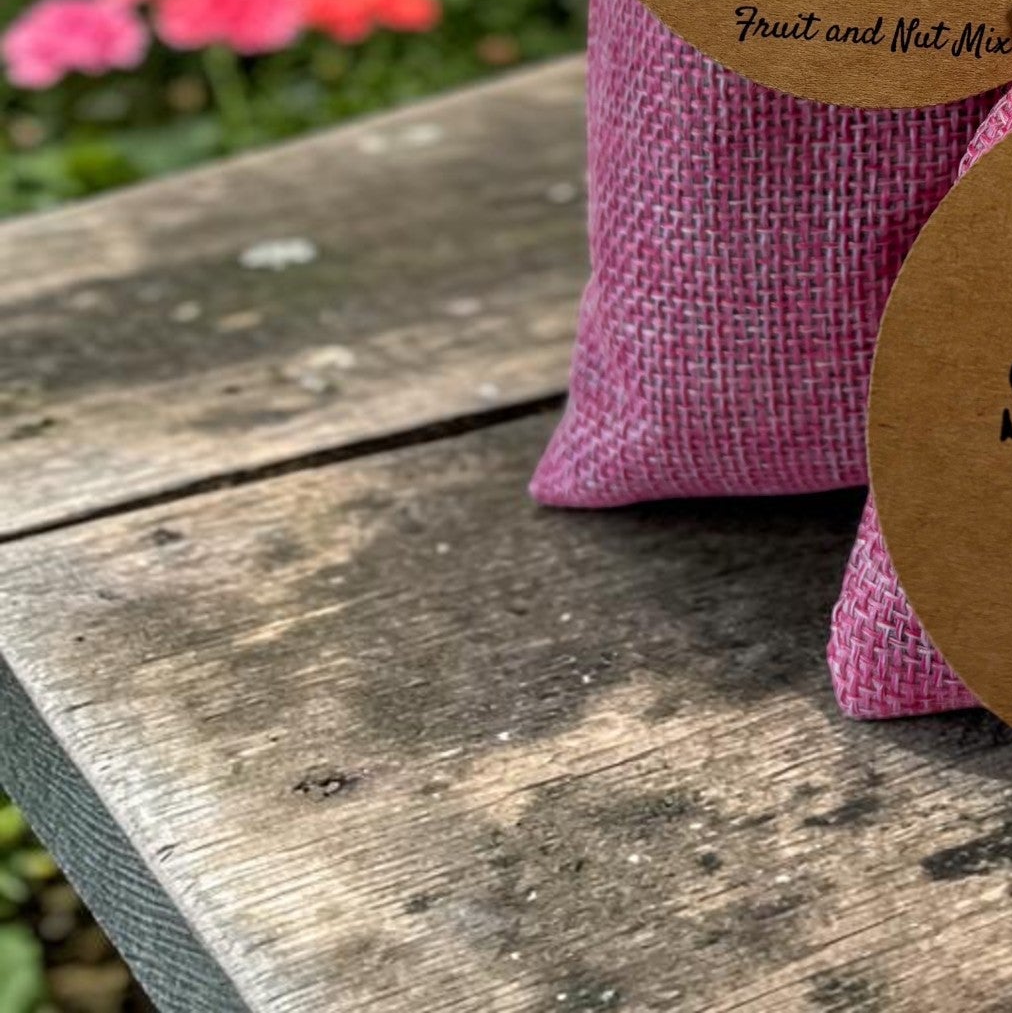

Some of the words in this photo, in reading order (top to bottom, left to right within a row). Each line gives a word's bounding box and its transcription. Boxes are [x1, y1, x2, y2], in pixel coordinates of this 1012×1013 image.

[735, 5, 819, 42] Fruit
[825, 19, 886, 45] and
[890, 17, 950, 54] Nut
[952, 22, 1012, 59] Mix
